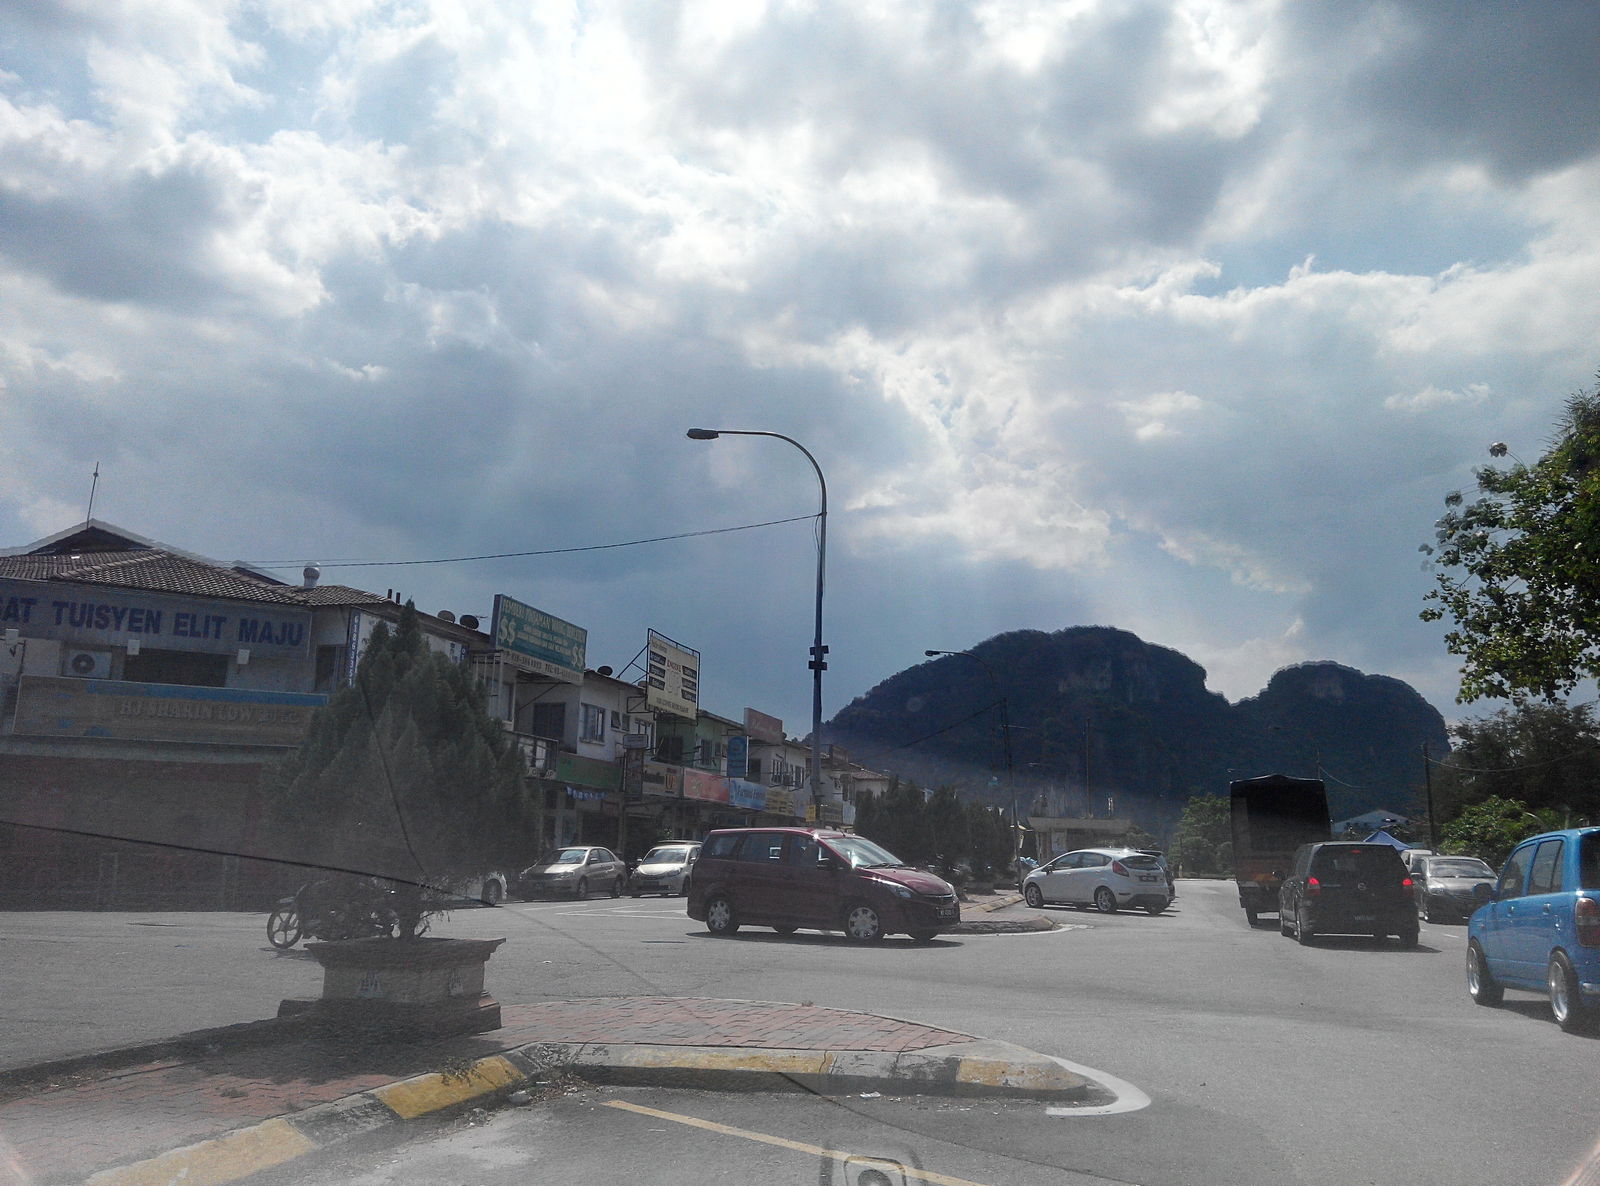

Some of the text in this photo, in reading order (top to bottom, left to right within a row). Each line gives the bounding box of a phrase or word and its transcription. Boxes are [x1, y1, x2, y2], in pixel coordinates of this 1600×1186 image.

[0, 596, 304, 647] AT TUISYEN ELIT MAJU
